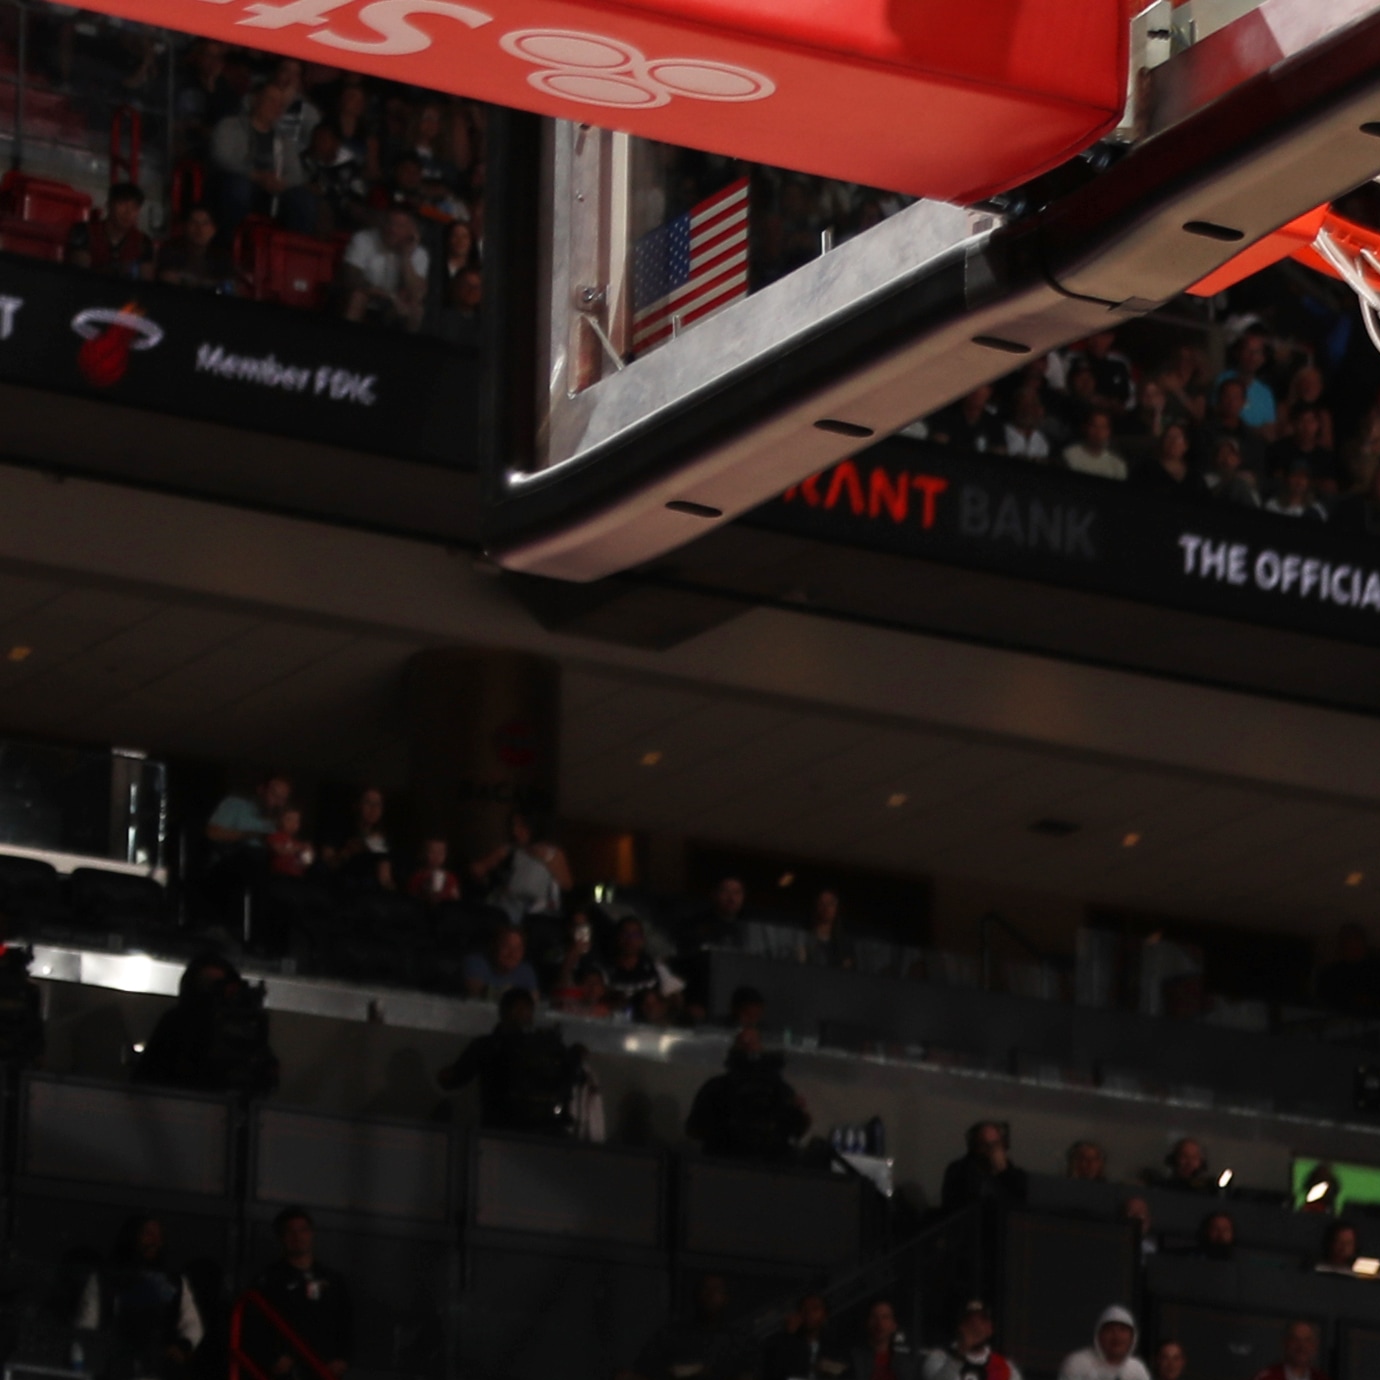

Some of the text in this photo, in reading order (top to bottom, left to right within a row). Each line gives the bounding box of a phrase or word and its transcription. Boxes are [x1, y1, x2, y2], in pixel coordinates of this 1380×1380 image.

[195, 343, 310, 392] Member
[958, 484, 1096, 556] BANK
[1178, 533, 1247, 585] THE
